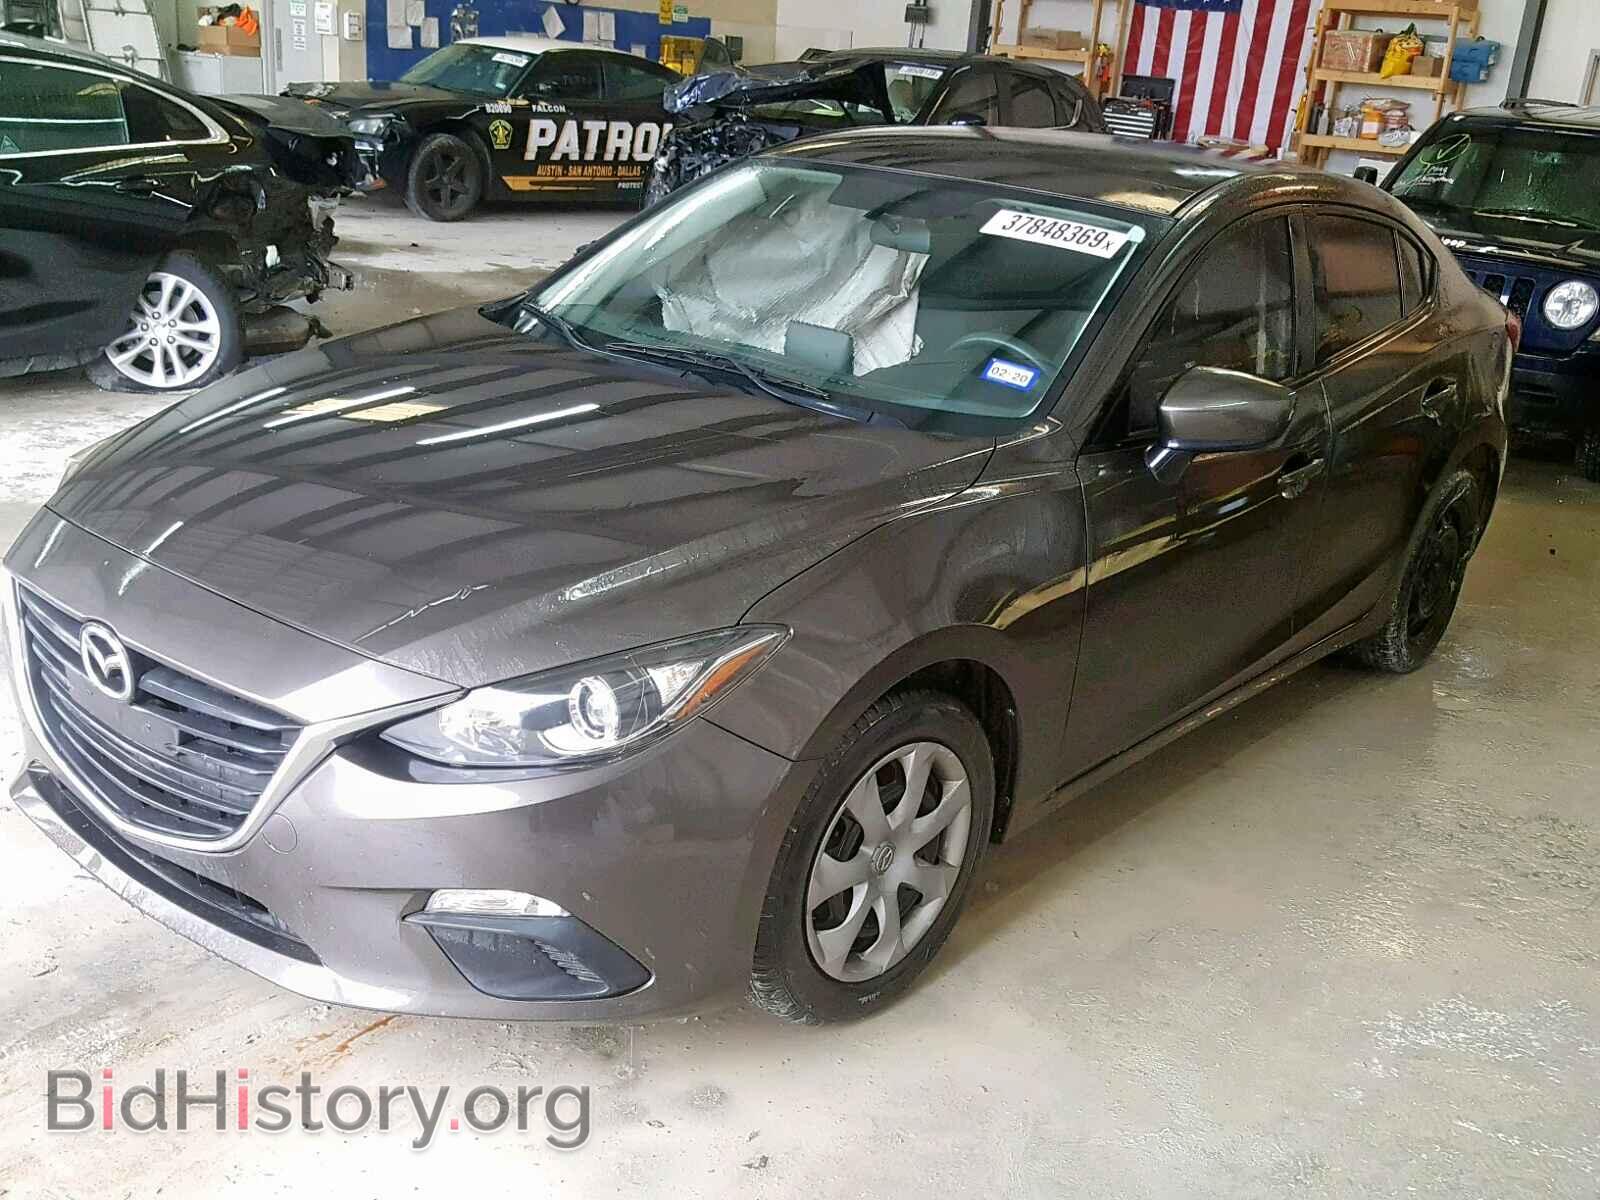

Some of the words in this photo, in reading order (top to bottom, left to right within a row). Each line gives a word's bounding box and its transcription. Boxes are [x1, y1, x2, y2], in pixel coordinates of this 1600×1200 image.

[532, 104, 566, 112] FALCON
[537, 165, 562, 176] AUSTIN
[568, 165, 583, 176] SAN
[583, 165, 612, 176] ANTONIO
[618, 165, 640, 177] DALLAS
